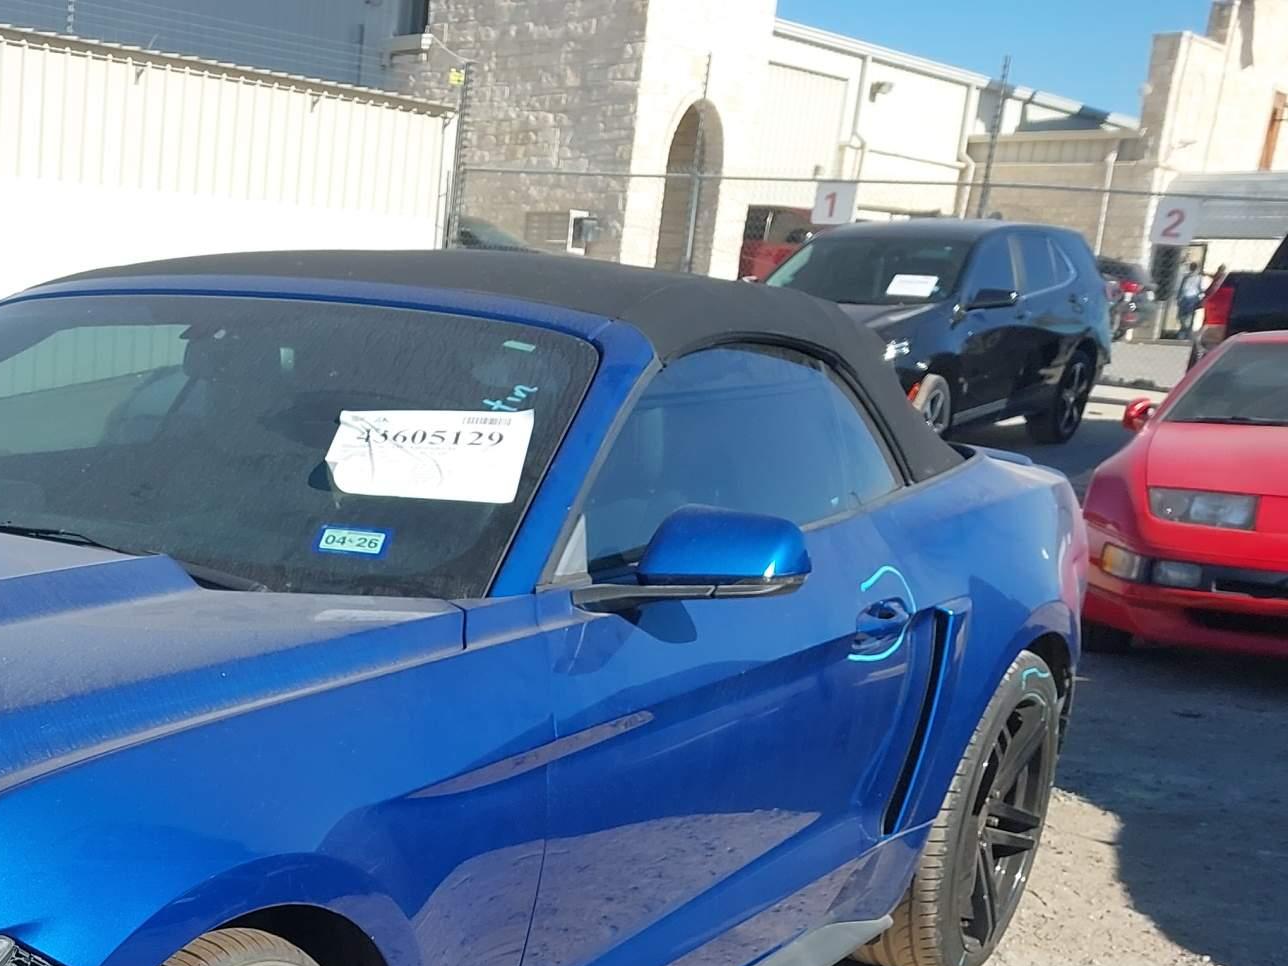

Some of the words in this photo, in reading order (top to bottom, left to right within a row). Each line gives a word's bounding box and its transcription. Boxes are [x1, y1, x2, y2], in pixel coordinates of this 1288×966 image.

[824, 192, 837, 218] 1
[1160, 208, 1186, 237] 2
[357, 428, 504, 447] 43605129
